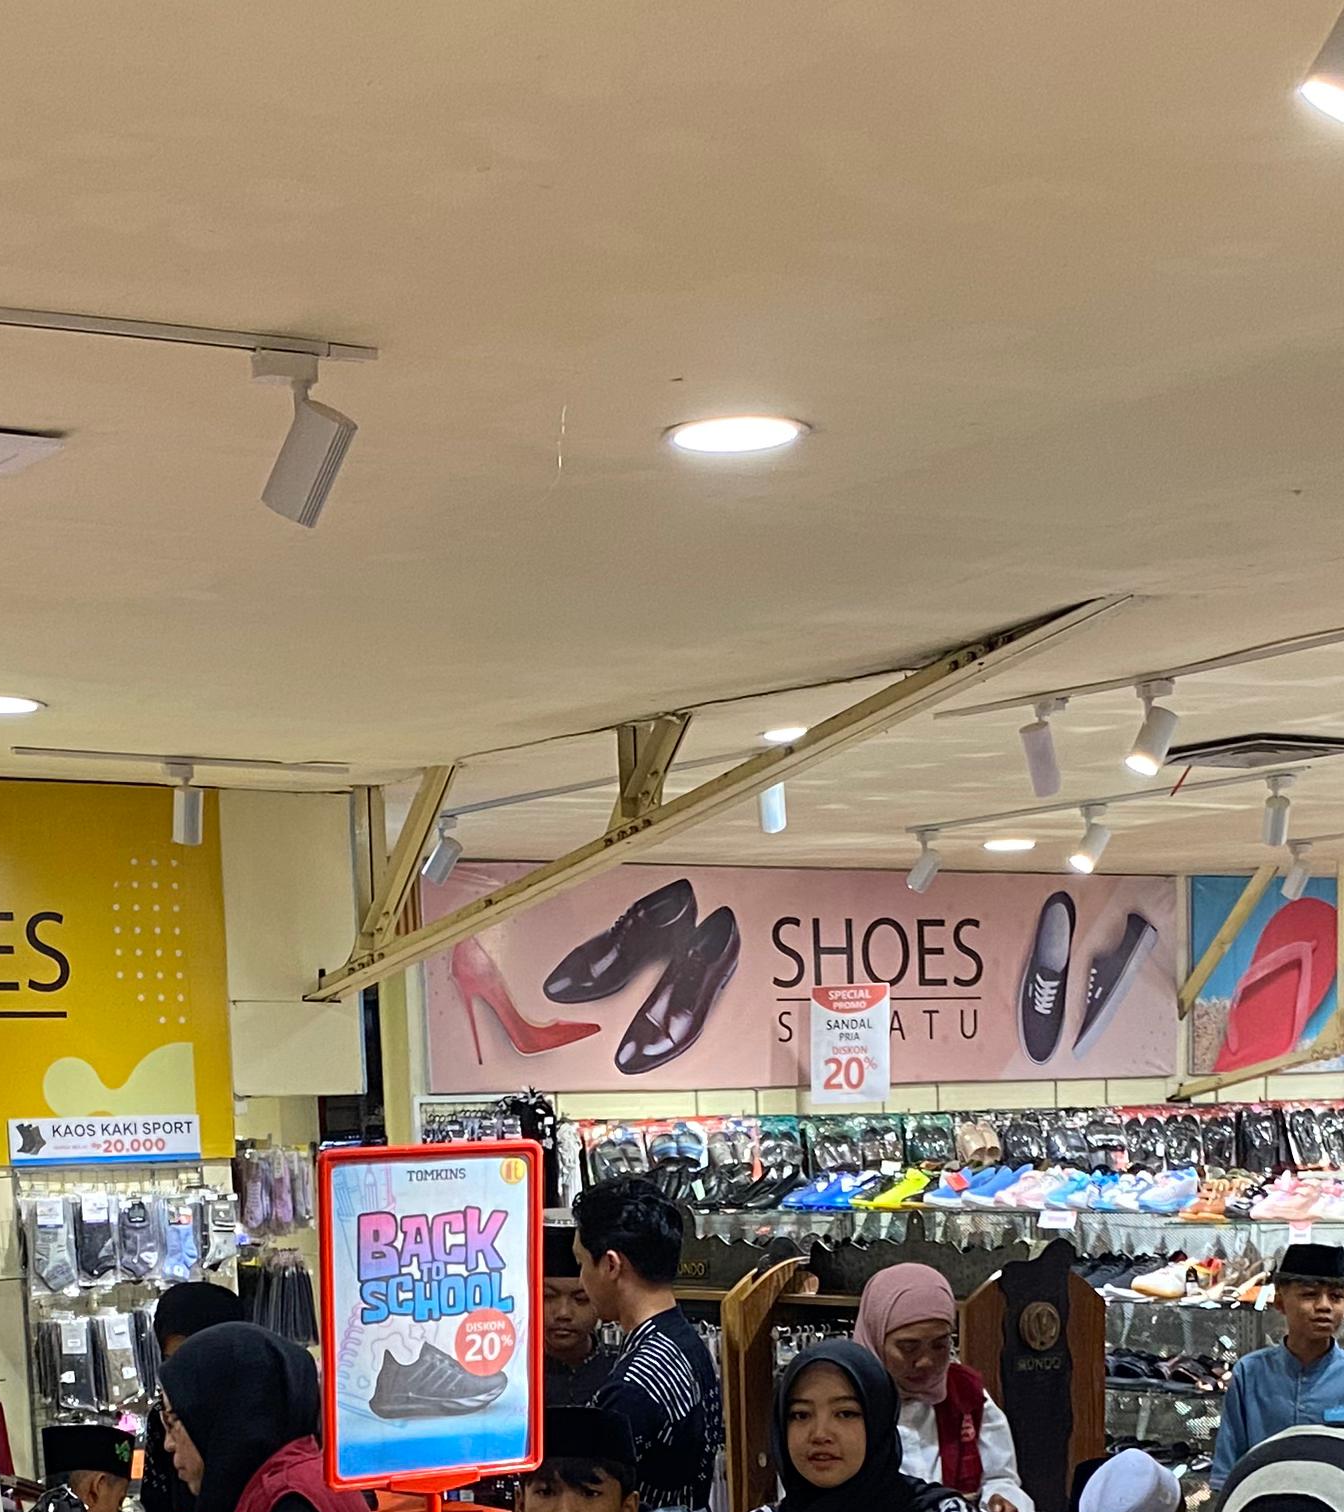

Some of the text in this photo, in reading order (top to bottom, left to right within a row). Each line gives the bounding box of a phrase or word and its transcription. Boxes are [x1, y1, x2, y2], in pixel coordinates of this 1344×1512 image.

[771, 916, 983, 988] SHOES
[827, 989, 872, 1000] SPECIAL
[825, 1018, 873, 1030] SANDAL
[838, 1031, 861, 1041] PRIA
[823, 1056, 878, 1090] 20%
[52, 1120, 193, 1137] KAOS KAKI SPORT
[406, 1167, 466, 1183] TOMKINS
[357, 1205, 508, 1284] BACK
[420, 1259, 445, 1282] TO
[359, 1271, 514, 1325] SCHOOL
[465, 1319, 506, 1333] DISKON
[464, 1333, 514, 1362] 20%
